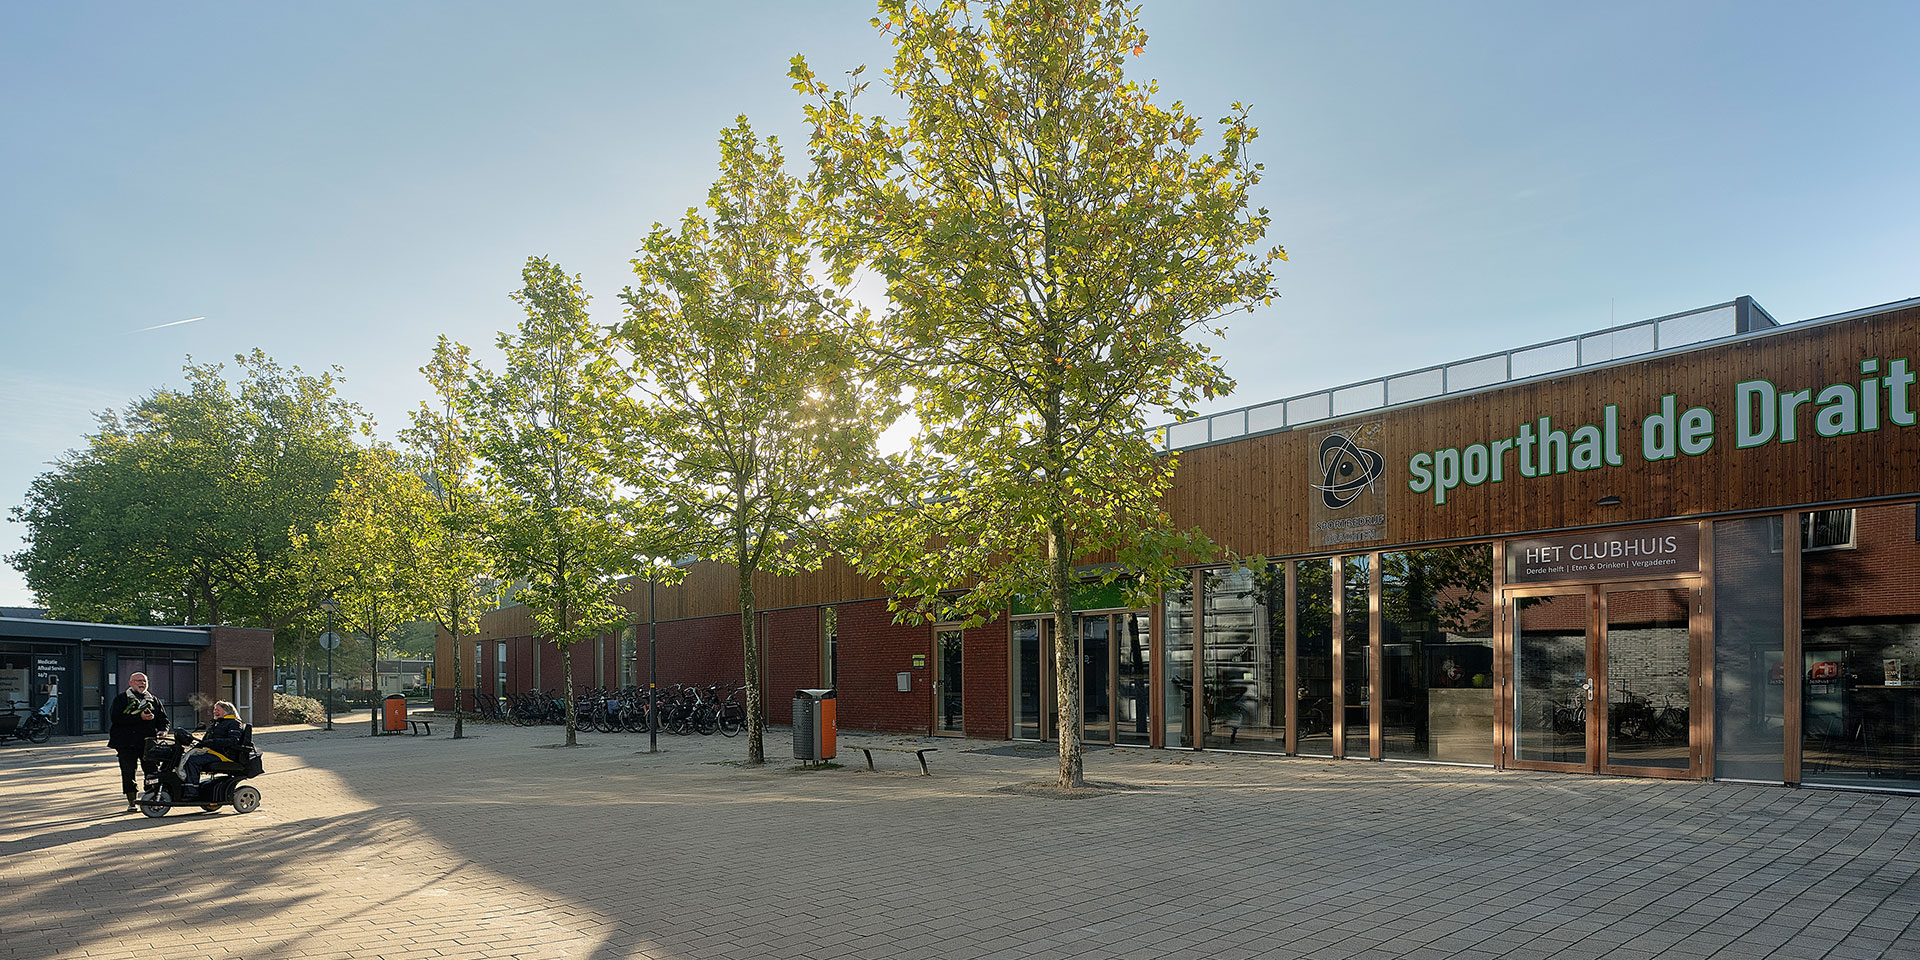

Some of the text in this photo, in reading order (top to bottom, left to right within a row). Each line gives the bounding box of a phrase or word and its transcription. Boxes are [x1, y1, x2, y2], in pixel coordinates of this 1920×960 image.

[1408, 357, 1917, 506] sporthal de Drait
[1316, 513, 1385, 531] SPORTBEDRIJF
[1526, 536, 1677, 564] HET CLUBHUIS
[1526, 567, 1547, 575] Derde
[1548, 565, 1565, 573] helft
[1571, 563, 1588, 572] Eten
[1631, 558, 1676, 568] Vergaderen
